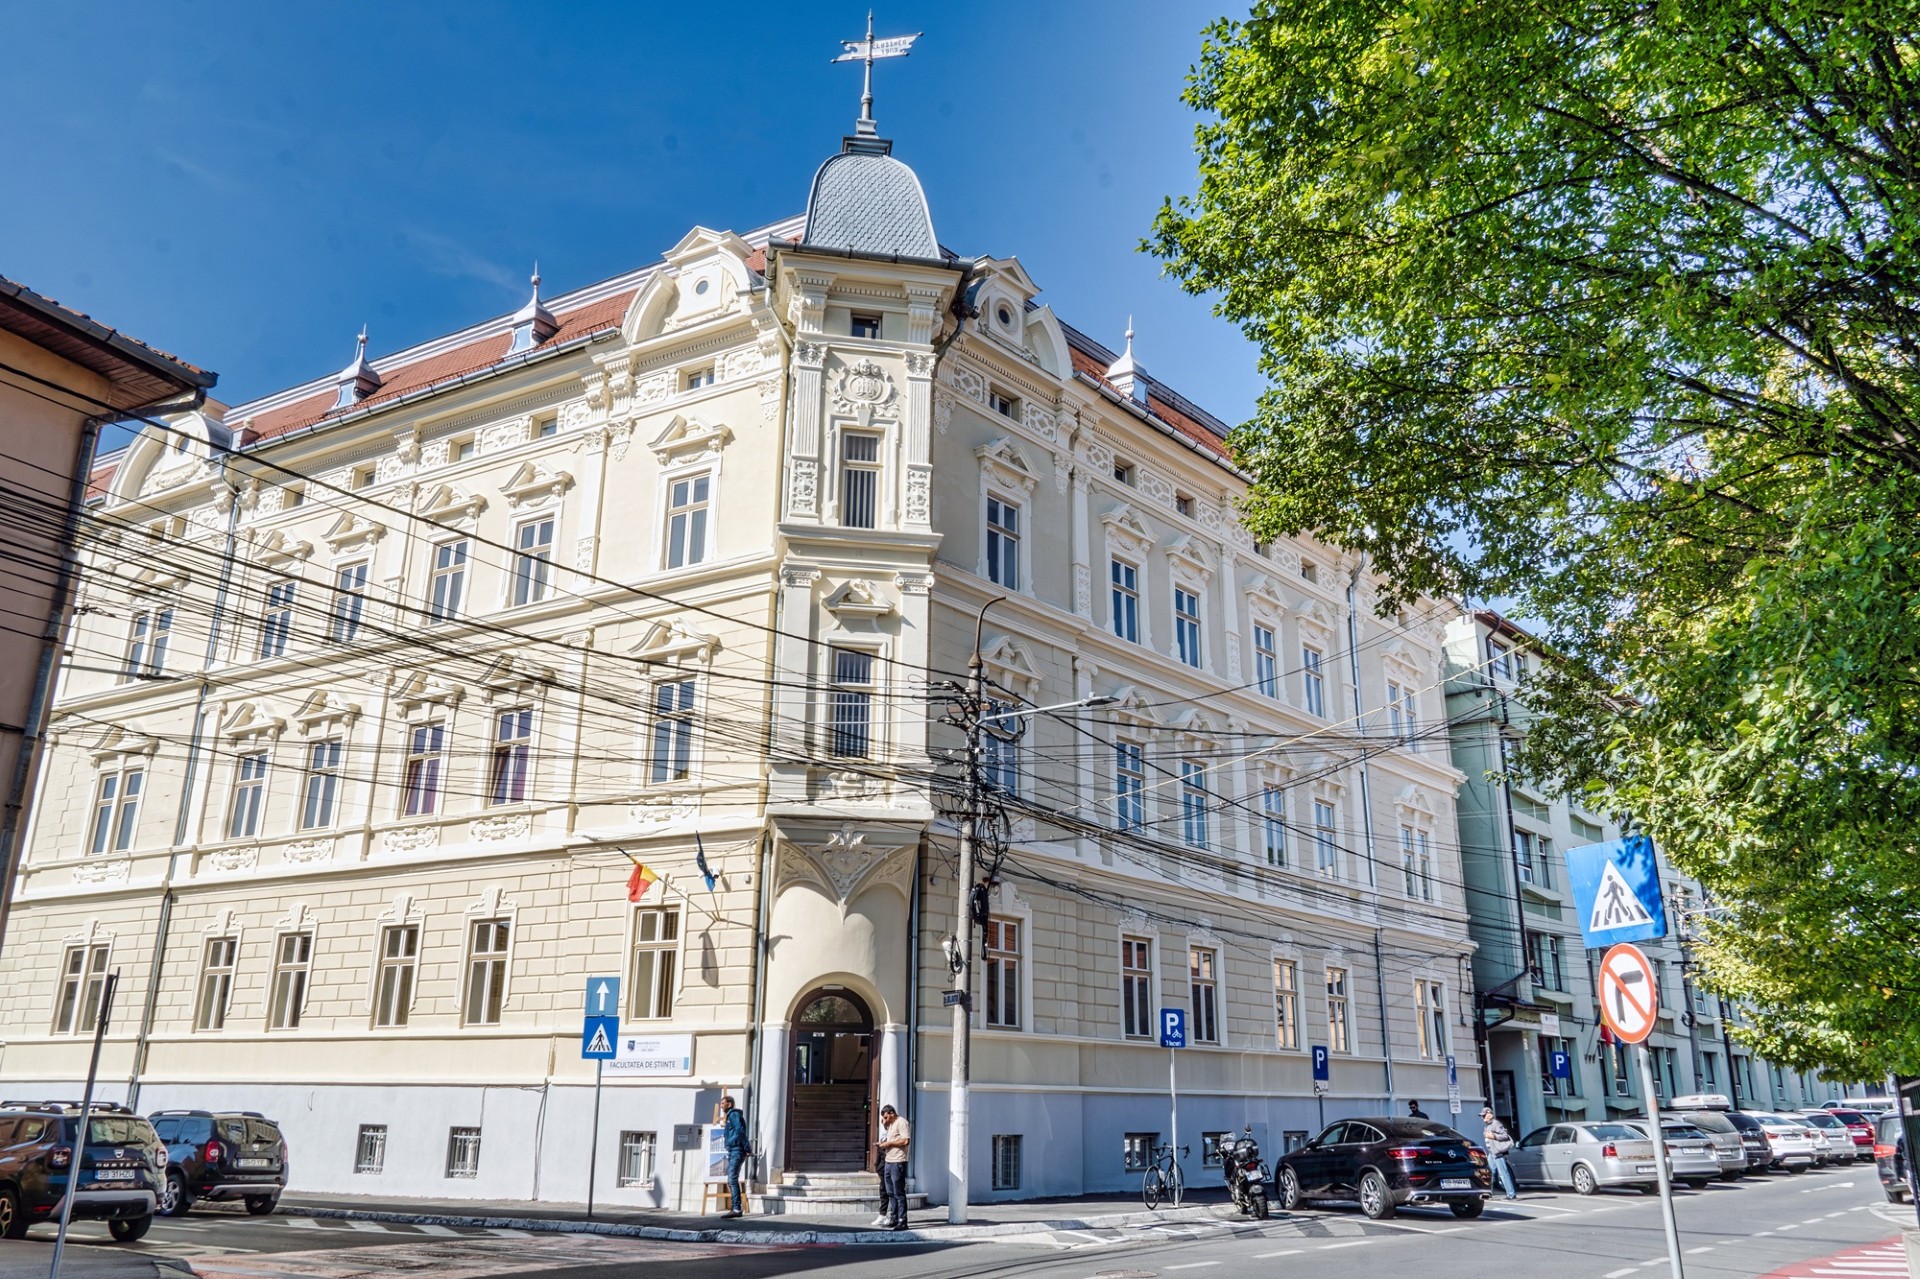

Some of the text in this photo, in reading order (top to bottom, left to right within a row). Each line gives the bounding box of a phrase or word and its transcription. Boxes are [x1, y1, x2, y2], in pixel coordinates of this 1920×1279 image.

[1166, 1013, 1179, 1035] P
[609, 1061, 643, 1069] FACULTATEA
[1316, 1050, 1325, 1069] P
[1555, 1054, 1565, 1070] P
[99, 1170, 109, 1179] SB
